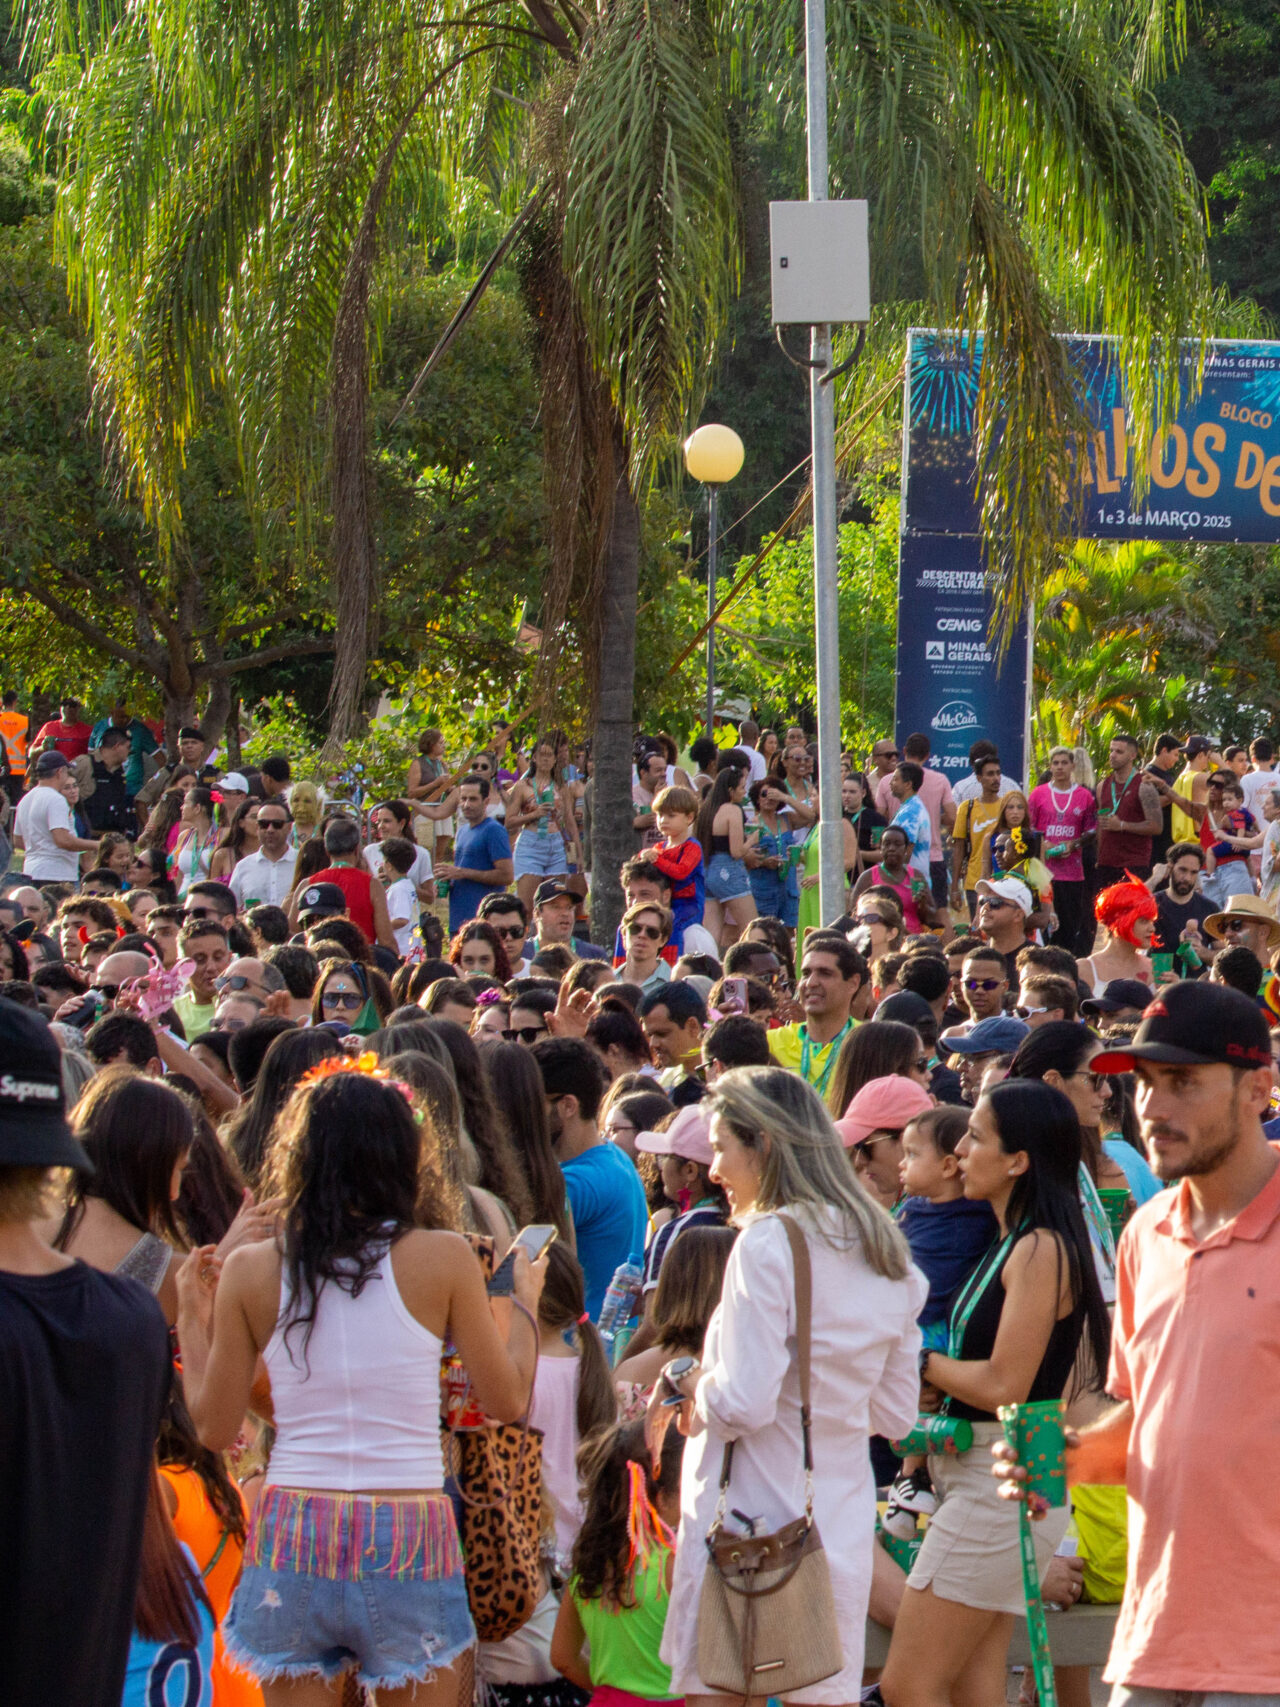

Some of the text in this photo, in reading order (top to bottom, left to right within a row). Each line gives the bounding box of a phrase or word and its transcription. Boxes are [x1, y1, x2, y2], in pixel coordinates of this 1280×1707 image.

[1238, 359, 1275, 369] GERAIS
[1204, 370, 1251, 379] presentam:
[1219, 400, 1272, 430] BLOCO
[1098, 509, 1105, 524] 1
[1116, 509, 1125, 525] 3
[1127, 511, 1142, 526] de
[1145, 510, 1200, 531] MARÇO
[1203, 515, 1232, 528] 2025
[936, 578, 985, 589] CULTURA
[936, 618, 982, 632] CEMIG
[947, 641, 986, 652] MINAS
[947, 651, 992, 662] GERAIS
[940, 711, 977, 727] McCain
[1054, 826, 1076, 837] BRB
